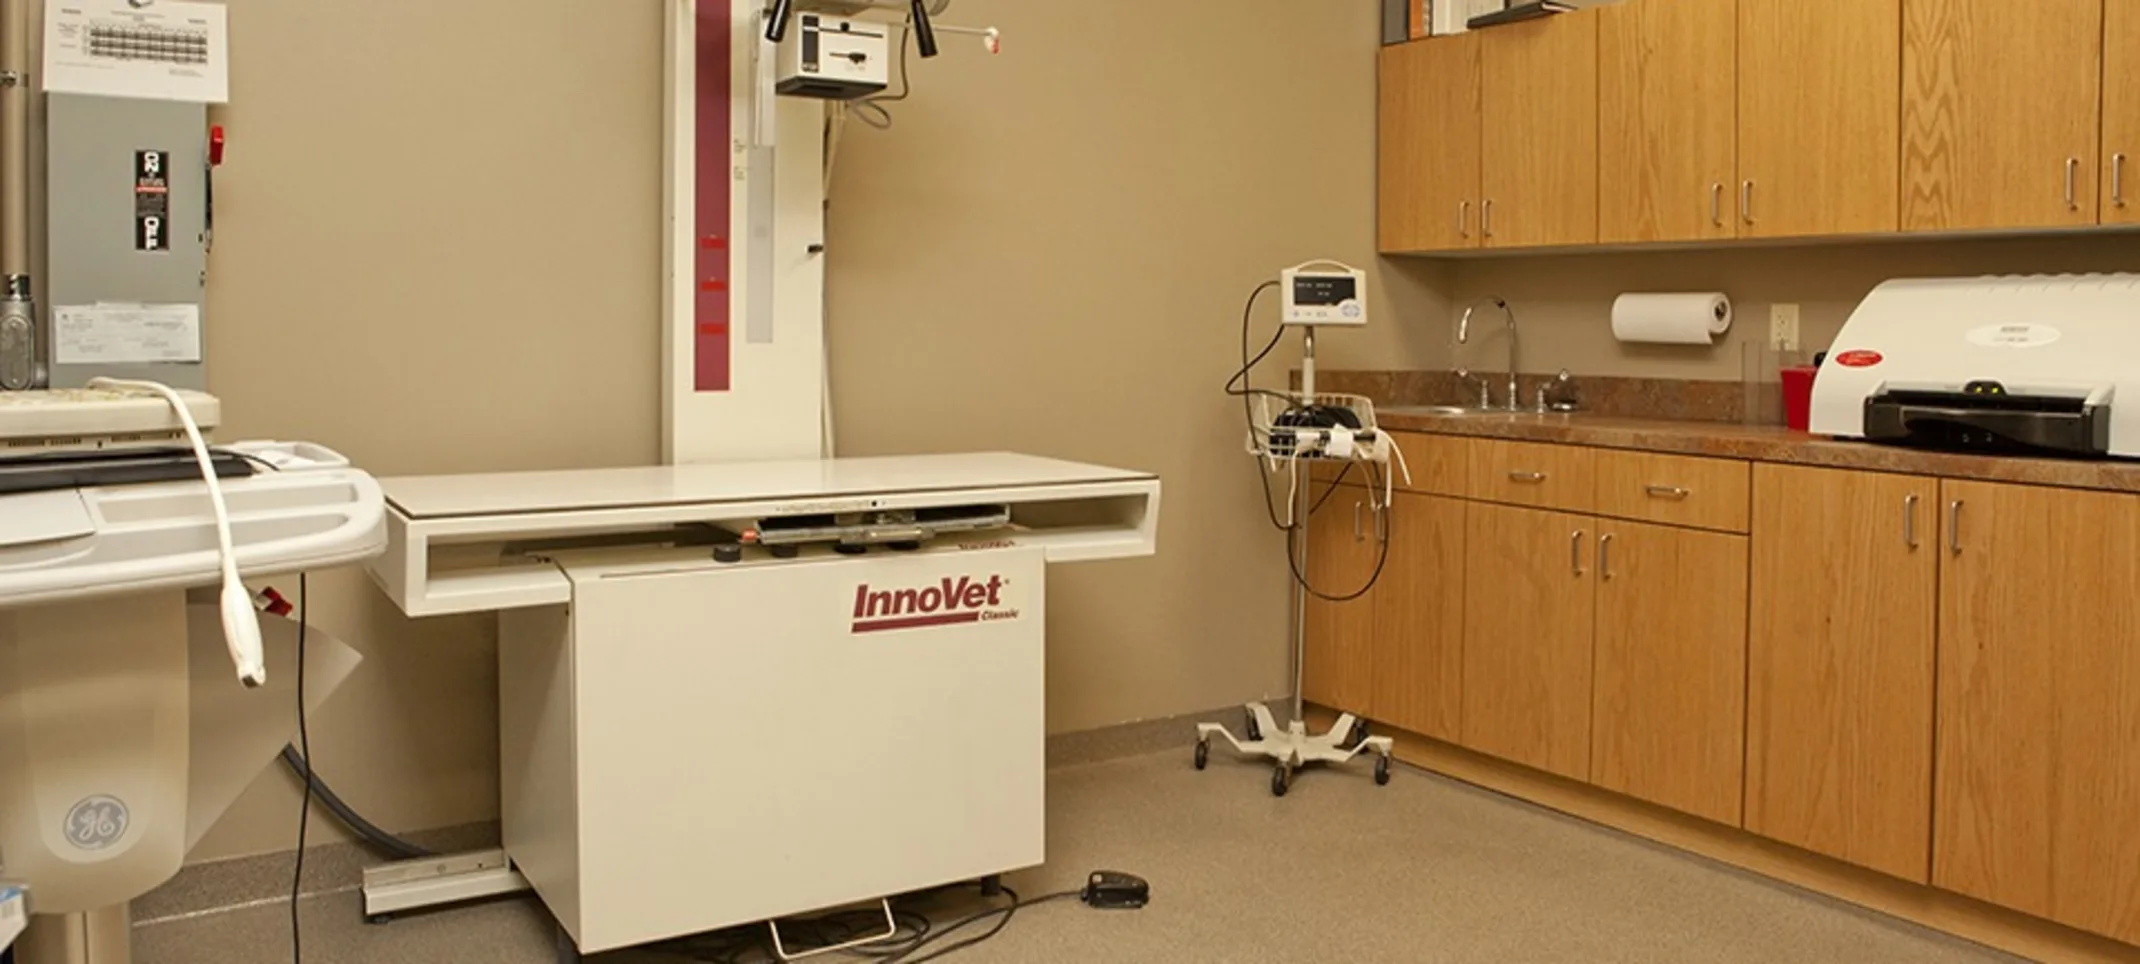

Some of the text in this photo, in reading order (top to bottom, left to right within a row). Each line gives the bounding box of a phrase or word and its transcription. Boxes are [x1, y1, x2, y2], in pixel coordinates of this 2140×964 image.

[144, 151, 159, 172] ON
[144, 216, 159, 250] OFF
[853, 574, 1001, 618] InnoVet
[981, 609, 1019, 621] Classic
